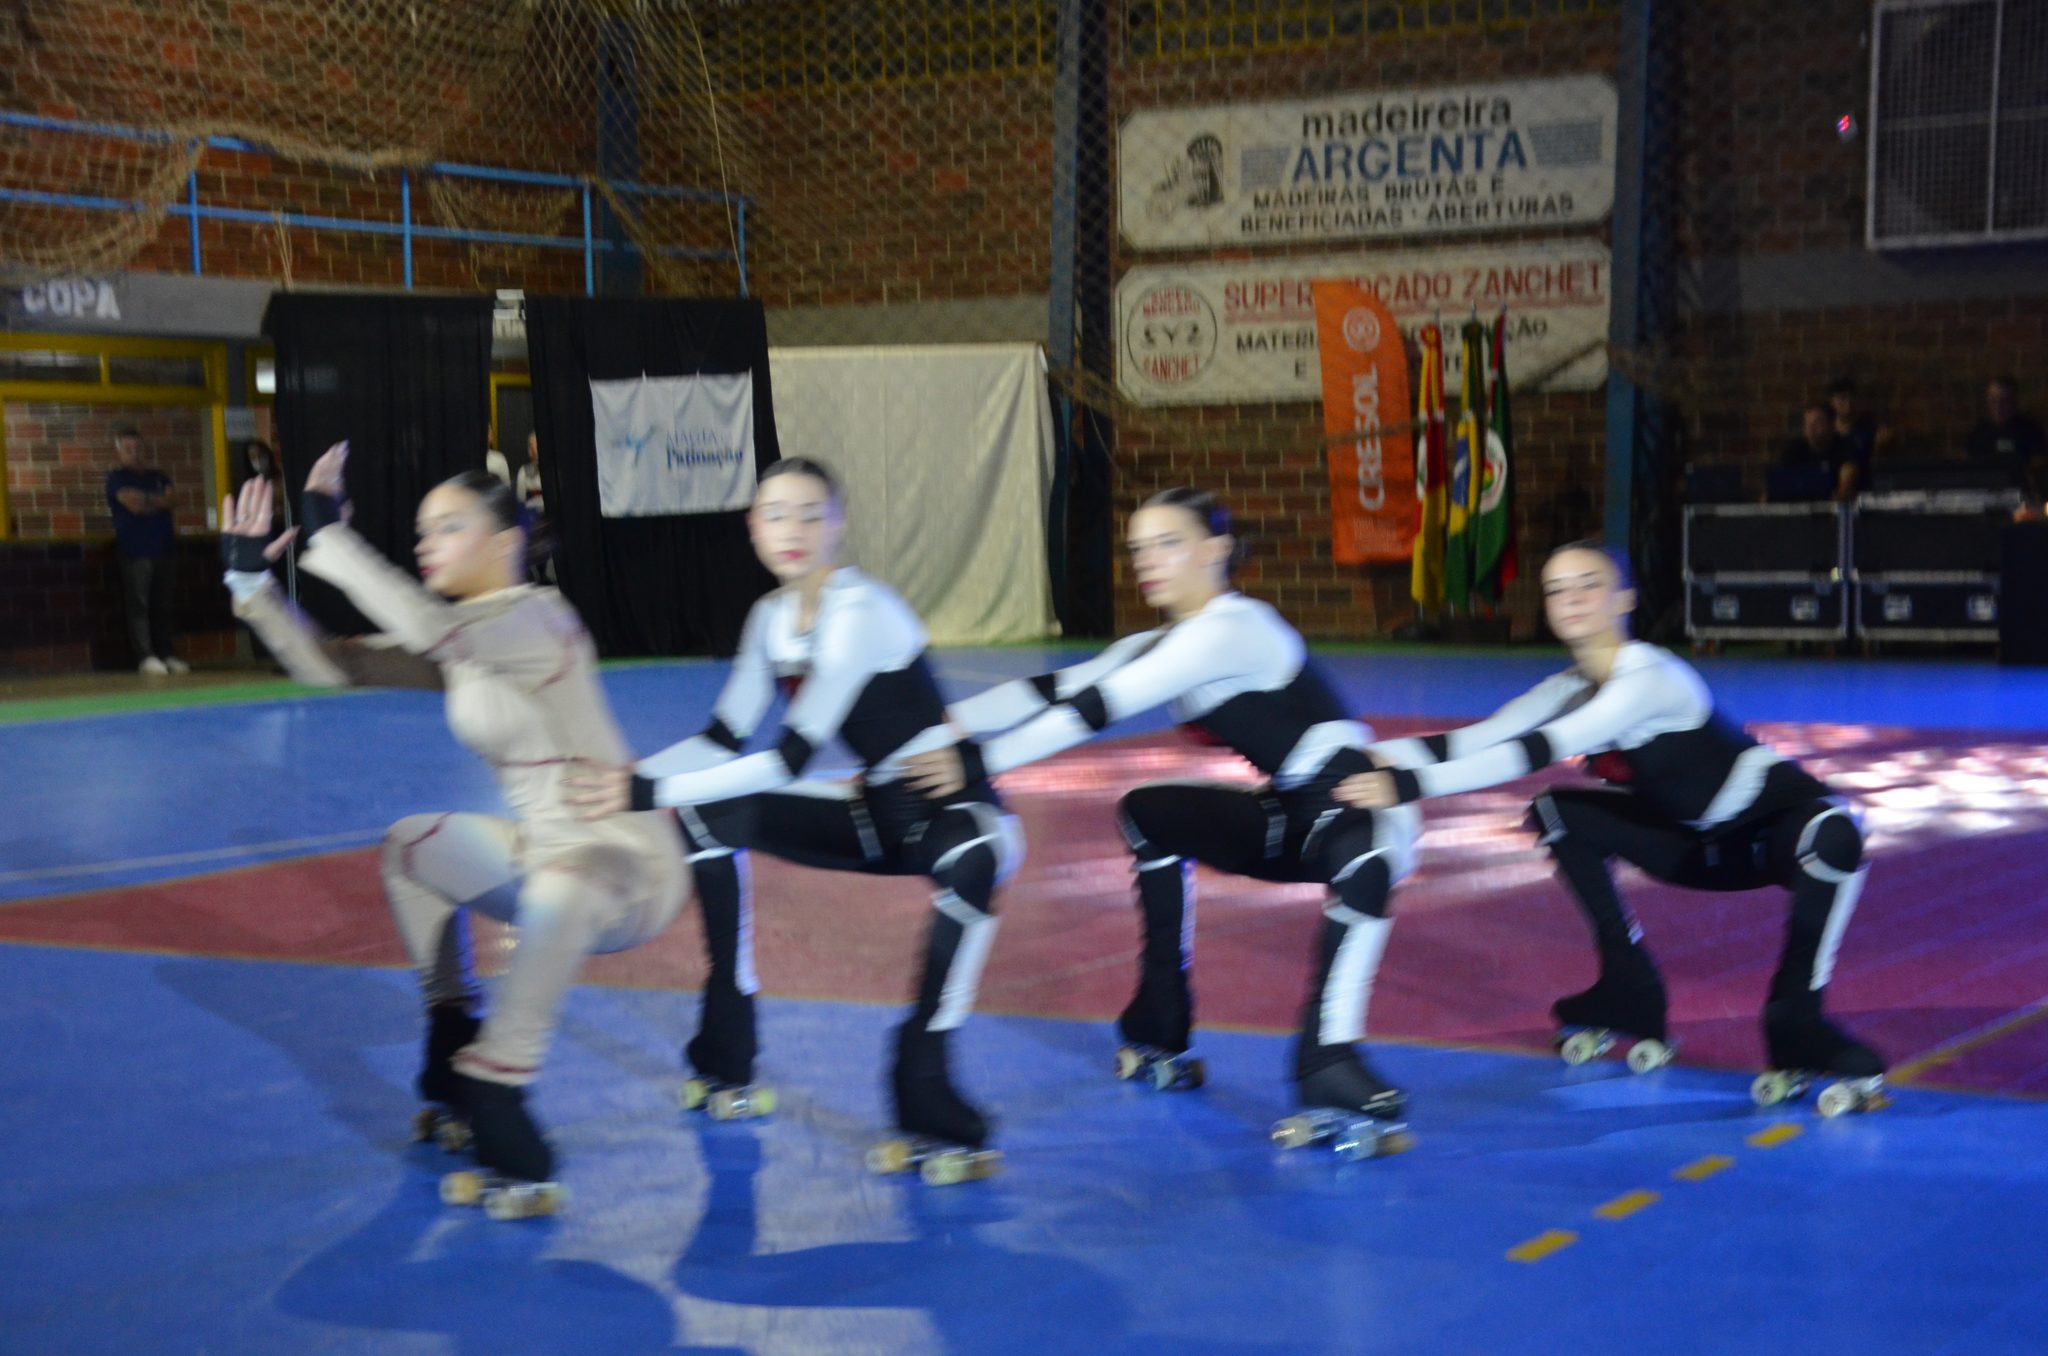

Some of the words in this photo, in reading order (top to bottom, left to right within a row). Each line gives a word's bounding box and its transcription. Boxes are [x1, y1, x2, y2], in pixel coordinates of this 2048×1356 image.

[1303, 94, 1511, 137] madeireira
[1293, 129, 1527, 182] ARGENTA
[1240, 206, 1403, 233] BENEFICIADAS
[1428, 191, 1574, 223] ABERTURAS
[1254, 184, 1369, 209] MADEIRAS
[1385, 175, 1477, 200] BRUTAS
[23, 279, 121, 320] COPA
[1225, 271, 1452, 309] SUPERCADO
[1463, 260, 1601, 298] ZANCHET
[1354, 363, 1385, 511] CRESOL
